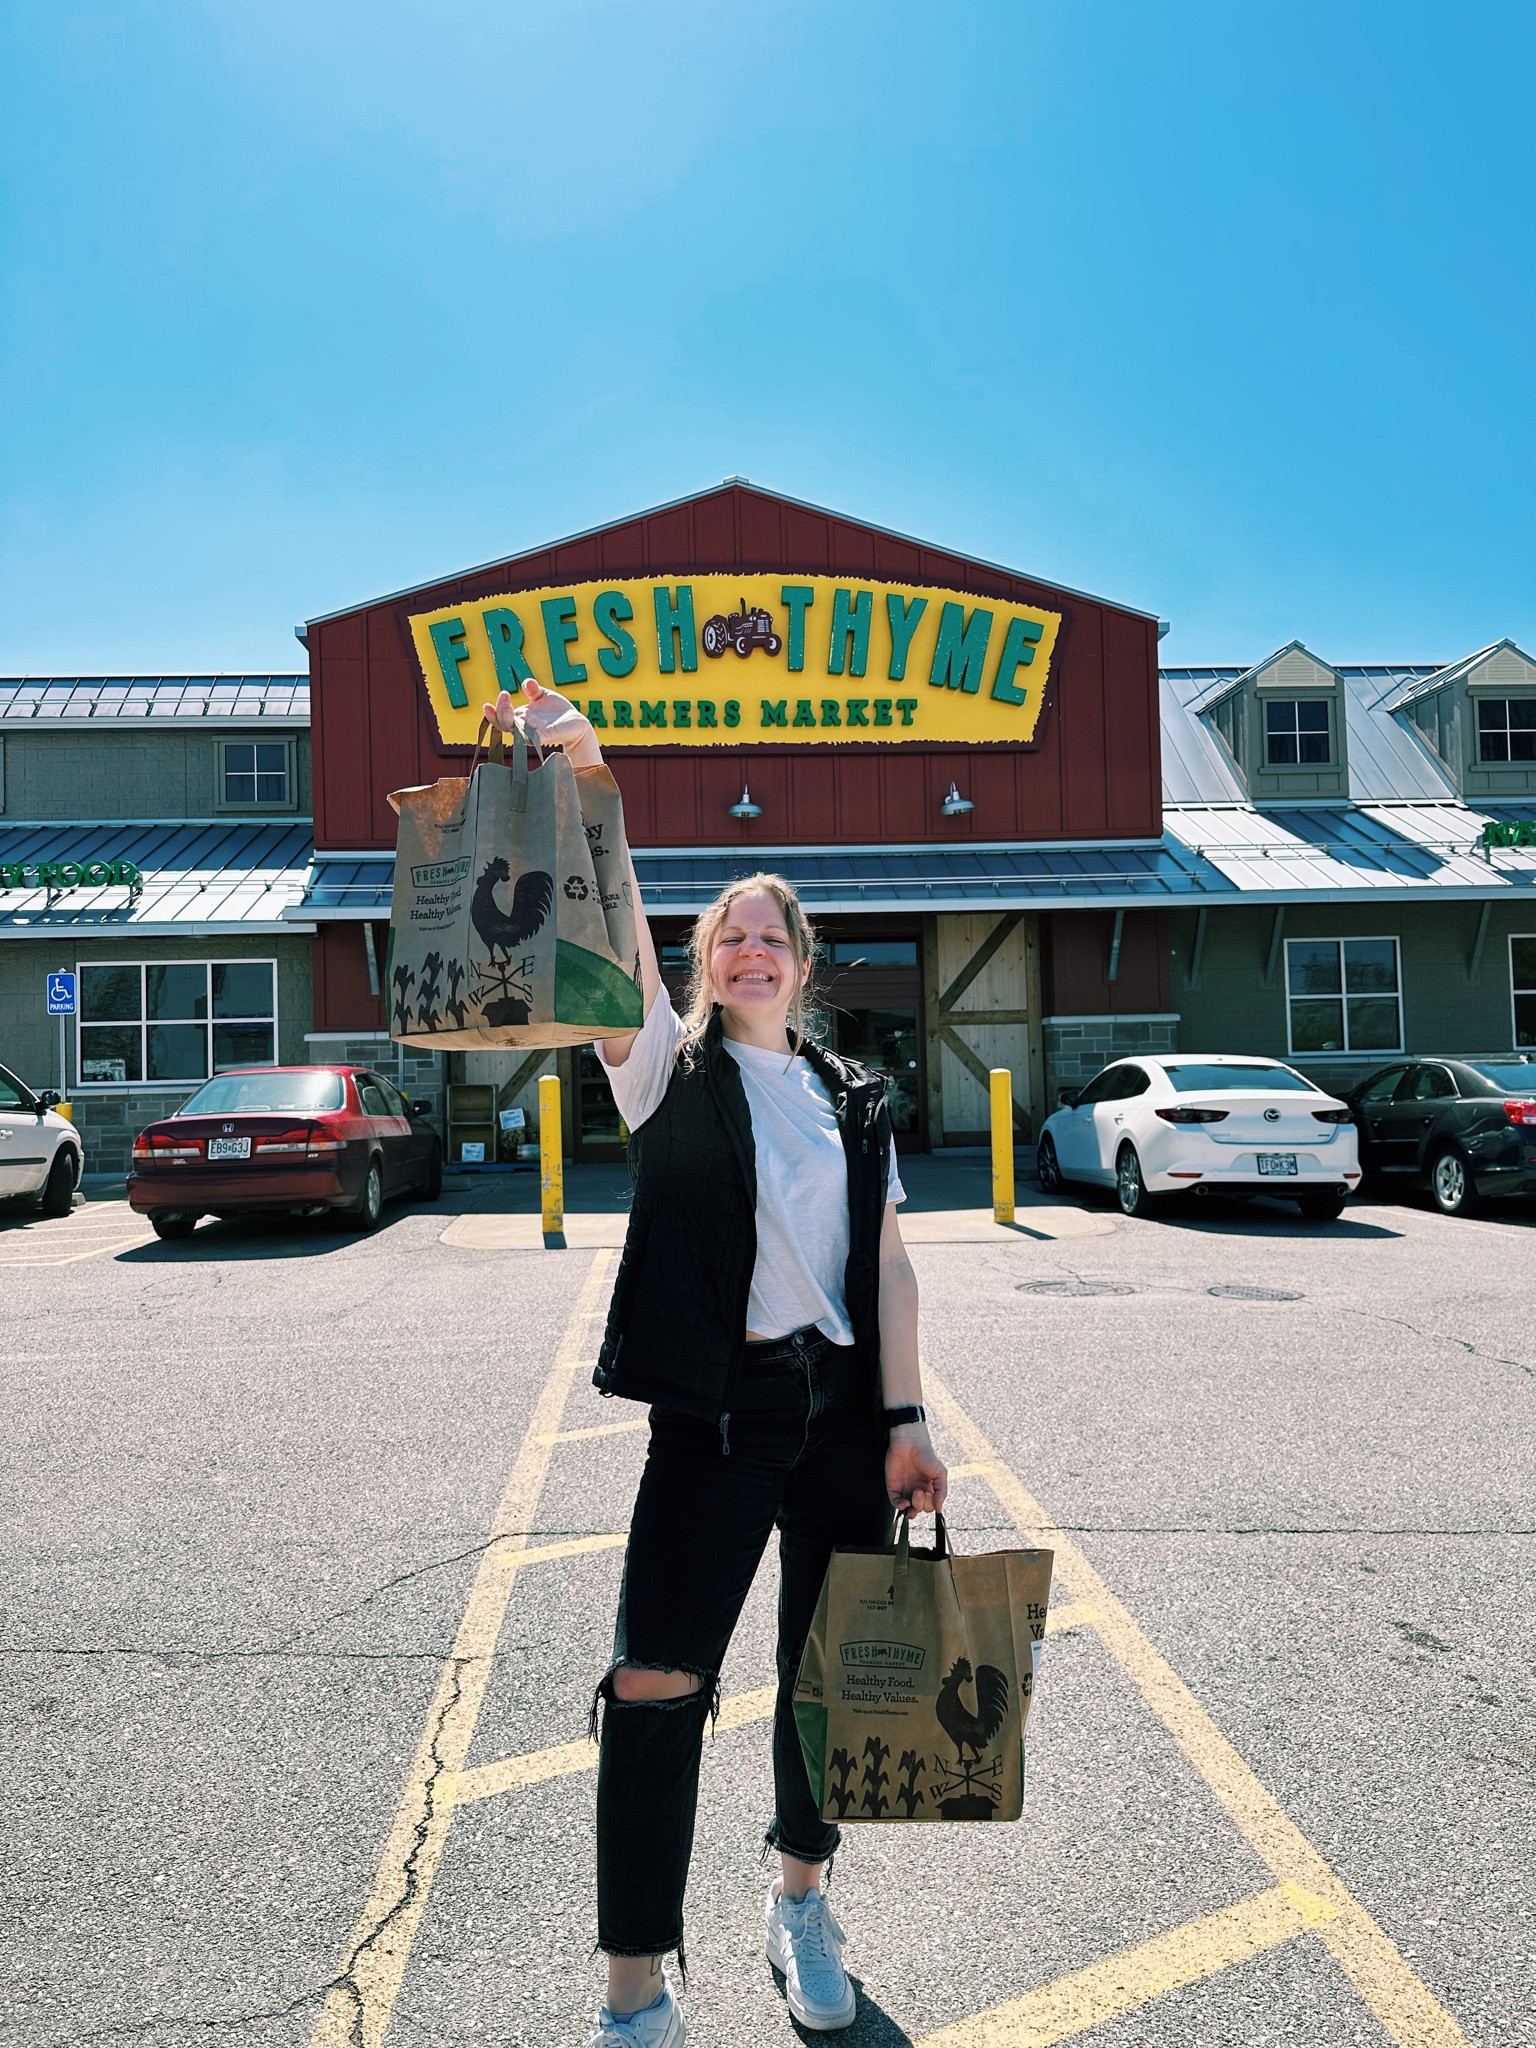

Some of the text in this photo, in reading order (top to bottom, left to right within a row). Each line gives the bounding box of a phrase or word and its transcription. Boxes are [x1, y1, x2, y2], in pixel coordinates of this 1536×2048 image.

[429, 585, 1044, 709] FRESH THYME
[571, 699, 918, 728] ARMERS MARKET
[36, 860, 138, 888] FOOD
[416, 866, 448, 882] FRESH
[416, 894, 450, 905] Healthy
[410, 908, 445, 920] Healthy
[844, 1646, 921, 1665] FRESH THYME
[846, 1674, 915, 1688] Healthy Food.
[841, 1690, 919, 1704] Healthy Values.
